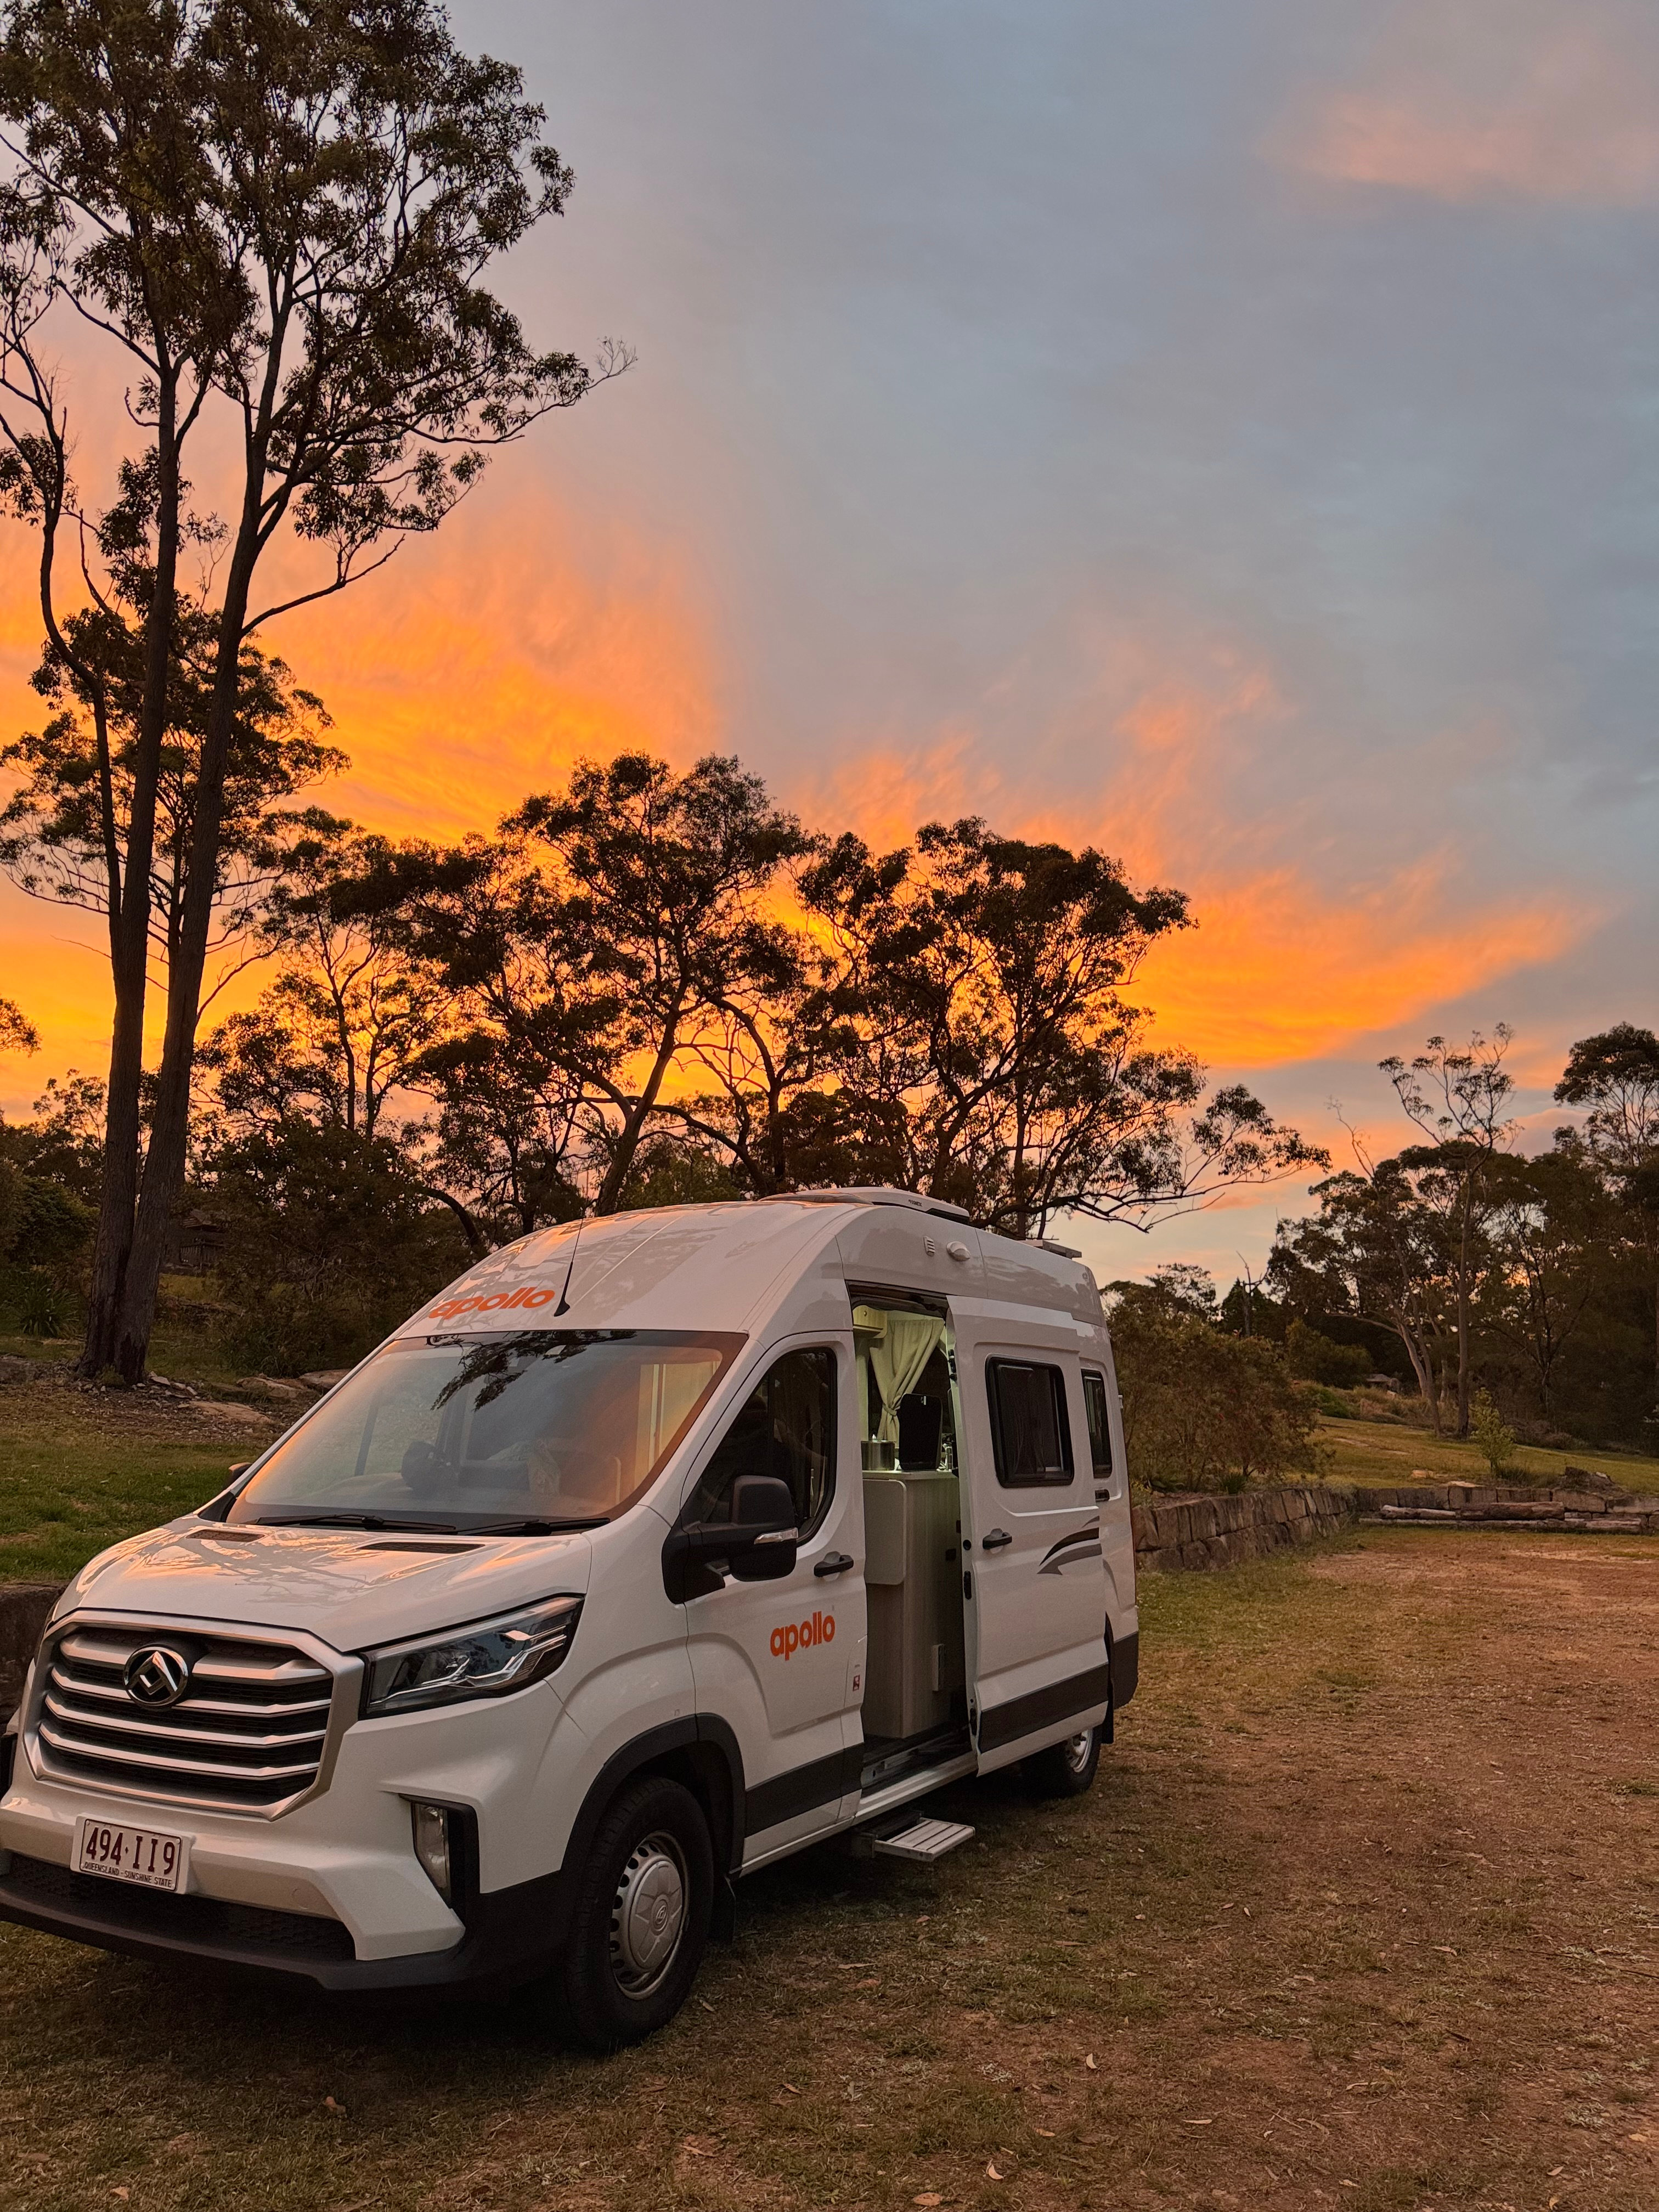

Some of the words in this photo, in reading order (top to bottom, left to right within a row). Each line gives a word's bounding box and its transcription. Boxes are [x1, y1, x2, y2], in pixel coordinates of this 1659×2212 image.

[428, 1286, 555, 1321] apollo
[770, 1611, 836, 1662] apollo
[84, 1861, 120, 1876] QUEENSLAND
[124, 1870, 153, 1883] SUNSHINE
[154, 1876, 172, 1888] STATE
